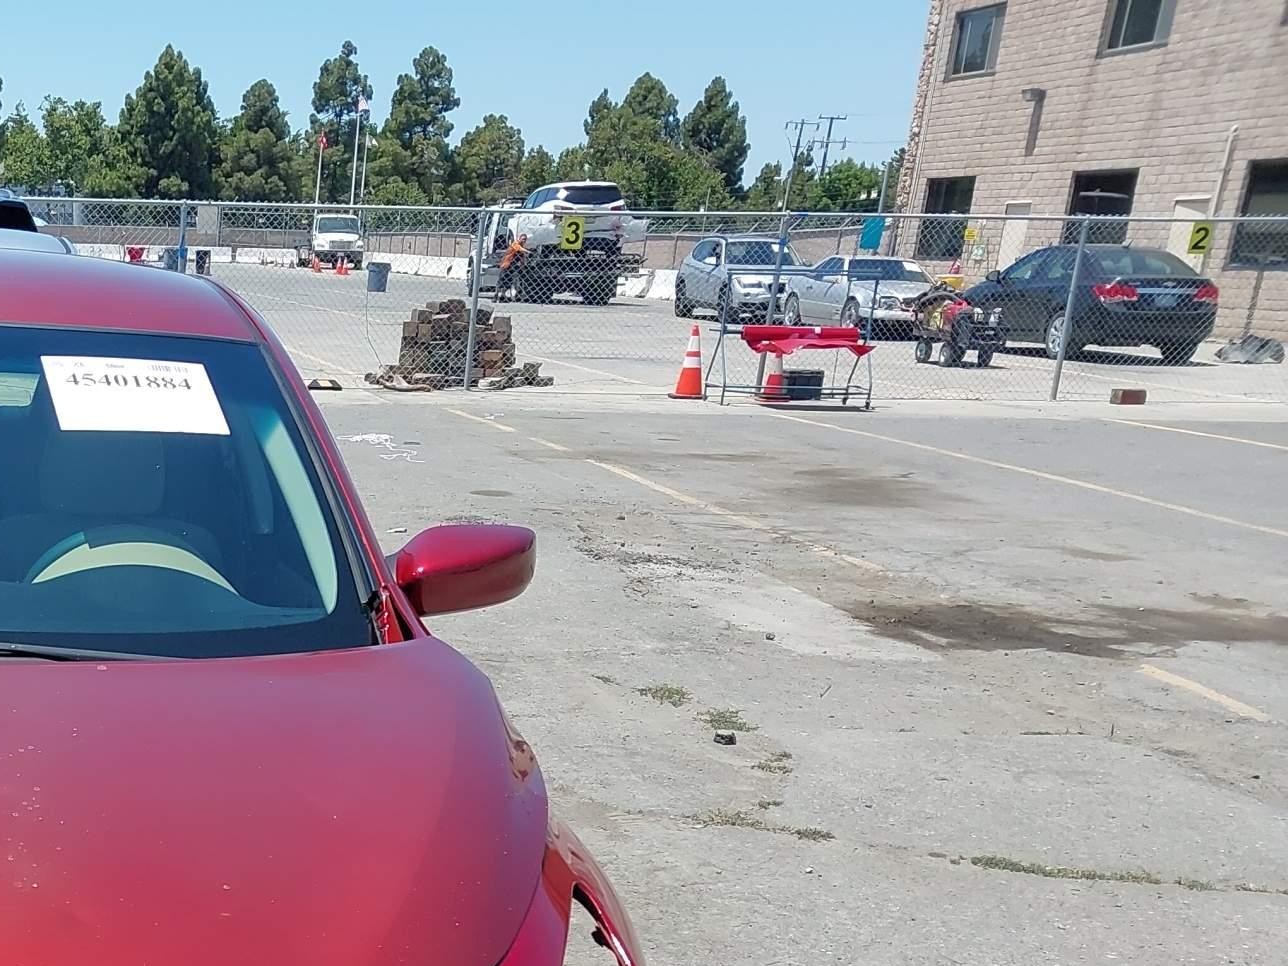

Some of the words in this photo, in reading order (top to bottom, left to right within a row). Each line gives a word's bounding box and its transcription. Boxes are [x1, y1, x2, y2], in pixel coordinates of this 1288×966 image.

[564, 221, 581, 245] 3
[1191, 226, 1210, 250] 2
[65, 372, 193, 391] 45401884
